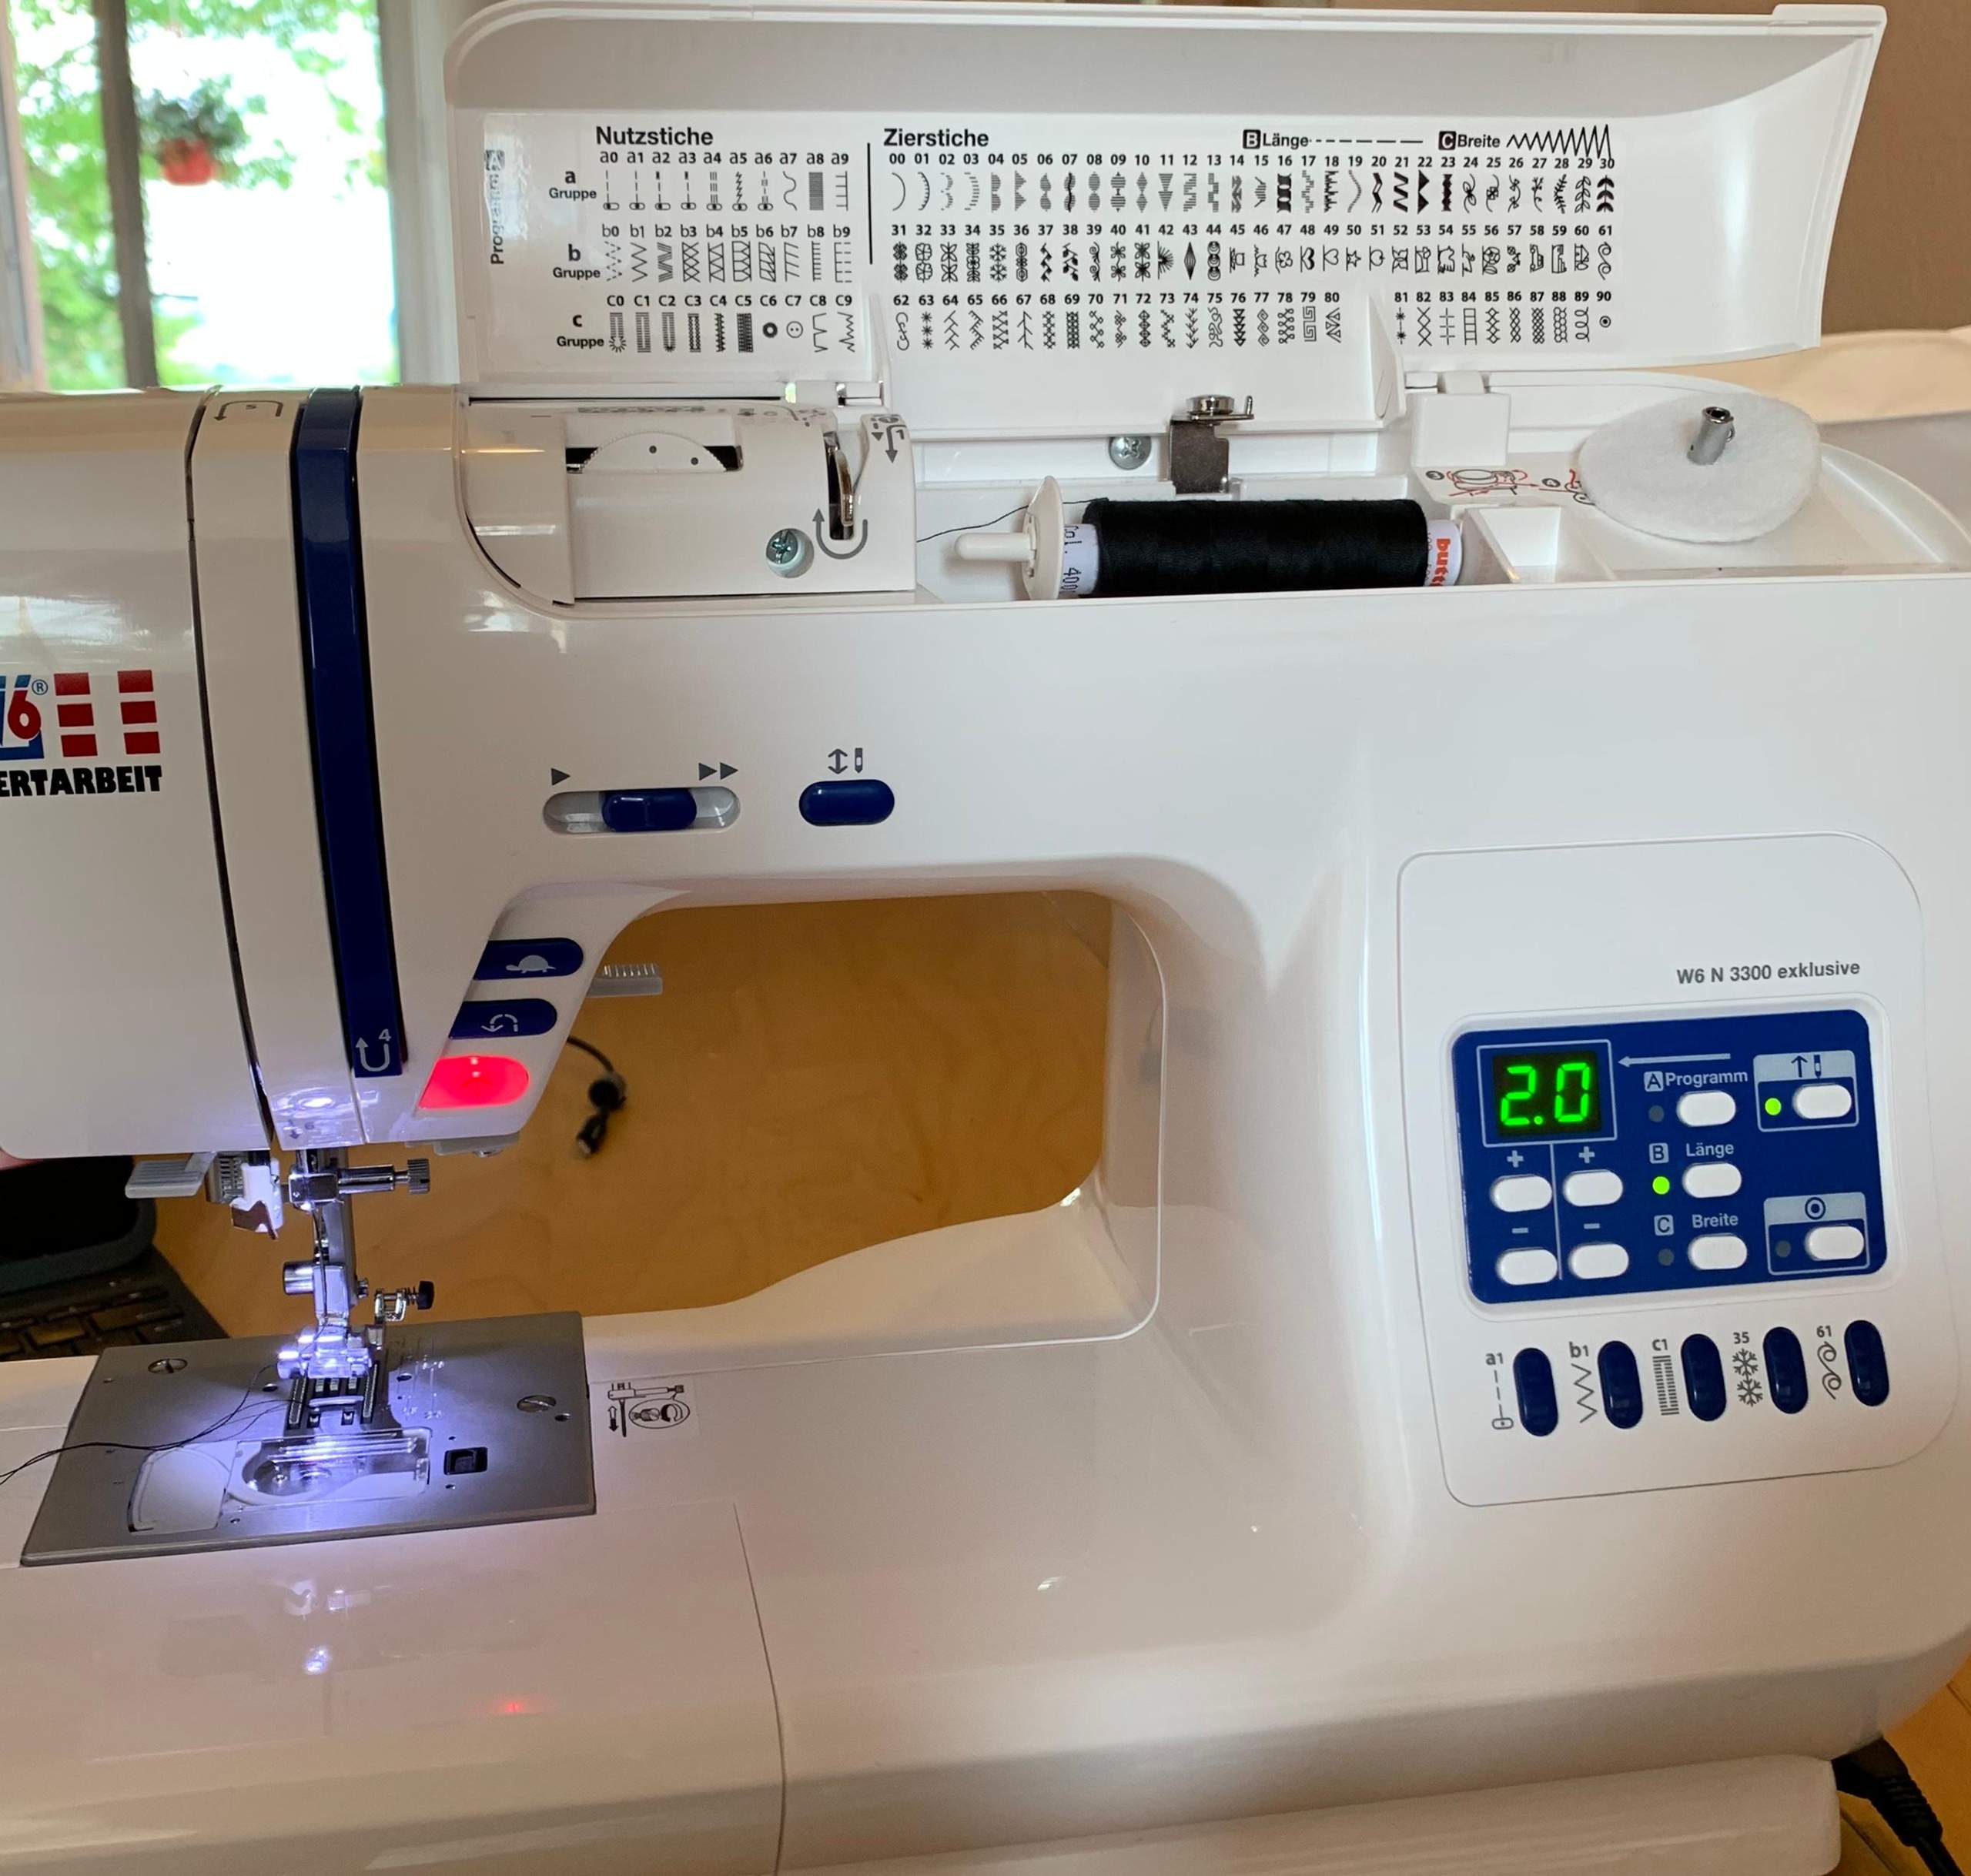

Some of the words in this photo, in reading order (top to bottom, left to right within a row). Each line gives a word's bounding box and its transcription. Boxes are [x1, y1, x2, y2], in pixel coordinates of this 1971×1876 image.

[596, 125, 714, 146] Nutzstiche
[883, 128, 989, 147] Zierstiche
[1263, 132, 1308, 150] Länge
[1457, 134, 1501, 148] Breite
[600, 151, 618, 163] a0
[627, 151, 644, 164] a1
[651, 152, 671, 164] a2
[678, 152, 696, 164] a3
[703, 152, 722, 164] a4
[729, 152, 748, 164] a5
[755, 152, 772, 165] a6
[779, 152, 797, 165] a7
[806, 152, 825, 165] a8
[831, 152, 849, 165] a9
[889, 152, 905, 165] 00
[914, 152, 929, 165] 01
[939, 153, 955, 166] 02
[963, 152, 979, 165] 03
[988, 153, 1004, 165] 04
[1012, 153, 1028, 166] 05
[1037, 153, 1053, 166] 06
[1062, 153, 1078, 166] 07
[1086, 154, 1103, 166] 08
[1110, 154, 1126, 166] 09
[1135, 154, 1149, 166] 10
[1160, 154, 1173, 166] 11
[1183, 154, 1197, 166] 12
[1207, 154, 1221, 166] 13
[1230, 154, 1244, 166] 14
[1254, 155, 1269, 166] 15
[1278, 155, 1293, 166] 16
[1301, 155, 1317, 166] 17
[1324, 155, 1339, 167] 18
[1348, 155, 1363, 167] 19
[1371, 155, 1387, 167] 20
[1394, 156, 1409, 168] 21
[1417, 156, 1433, 168] 22
[1441, 156, 1456, 168] 23
[1463, 156, 1478, 168] 24
[1486, 156, 1501, 168] 25
[1508, 157, 1524, 169] 26
[1532, 157, 1548, 169] 27
[564, 171, 576, 184] a
[549, 187, 597, 202] Gruppe
[602, 225, 619, 238] b0
[630, 225, 644, 239] b1
[655, 225, 672, 238] b2
[680, 225, 698, 238] b3
[706, 225, 724, 238] b4
[731, 225, 748, 238] b5
[756, 225, 774, 238] b6
[781, 225, 798, 238] b7
[807, 225, 825, 238] b8
[833, 225, 851, 238] b9
[892, 224, 905, 236] 31
[915, 224, 932, 236] 32
[940, 224, 955, 236] 33
[965, 224, 981, 236] 34
[989, 224, 1005, 236] 35
[1013, 224, 1029, 236] 36
[1038, 224, 1053, 236] 37
[1062, 224, 1079, 236] 38
[1086, 224, 1102, 236] 39
[1110, 224, 1126, 236] 40
[1135, 224, 1149, 236] 41
[1158, 224, 1174, 236] 42
[1183, 224, 1198, 236] 43
[1206, 223, 1222, 236] 44
[1230, 224, 1245, 236] 45
[1253, 224, 1269, 236] 46
[1277, 224, 1292, 236] 47
[1300, 224, 1315, 236] 48
[1346, 224, 1362, 236] 50
[1370, 224, 1384, 236] 51
[1393, 224, 1408, 236] 52
[1416, 224, 1431, 236] 53
[1438, 224, 1454, 236] 54
[1461, 224, 1476, 236] 55
[1484, 225, 1499, 236] 56
[1507, 224, 1522, 236] 57
[1529, 225, 1544, 236] 58
[1552, 225, 1567, 236] 59
[1574, 225, 1589, 236] 60
[1598, 225, 1612, 236] 61
[568, 243, 581, 262] b
[553, 266, 601, 280] Gruppe
[893, 294, 909, 306] 62
[919, 294, 935, 306] 63
[942, 294, 959, 306] 64
[967, 294, 983, 306] 65
[992, 294, 1008, 306] 66
[1016, 293, 1032, 306] 67
[1039, 293, 1056, 305] 68
[1064, 293, 1080, 305] 69
[1088, 293, 1103, 305] 70
[1113, 293, 1127, 304] 71
[1136, 293, 1151, 304] 72
[1160, 293, 1175, 304] 73
[1183, 292, 1199, 304] 74
[1207, 293, 1223, 303] 75
[1230, 292, 1247, 303] 76
[1253, 292, 1270, 303] 77
[1277, 292, 1293, 303] 78
[1300, 291, 1316, 303] 79
[1324, 292, 1340, 303] 80
[1394, 292, 1407, 303] 81
[1416, 291, 1431, 303] 82
[1439, 291, 1454, 302] 83
[1484, 291, 1500, 302] 85
[1507, 290, 1522, 302] 86
[1530, 291, 1544, 303] 87
[1551, 291, 1567, 302] 88
[1574, 291, 1589, 302] 89
[1596, 290, 1611, 302] 90
[557, 336, 604, 349] Gruppe
[1061, 567, 1081, 593] 400
[1677, 968, 1705, 984] W6
[1711, 967, 1724, 982] N
[1730, 965, 1772, 981] 3300
[1777, 961, 1860, 978] exklusive
[378, 1028, 392, 1042] 4
[1665, 1069, 1748, 1088] Programm
[1500, 1062, 1591, 1126] 2.0
[1685, 1141, 1735, 1159] Länge
[1692, 1212, 1738, 1229] Breite
[1733, 1332, 1750, 1344] 35
[1816, 1326, 1832, 1338] 61
[1568, 1341, 1589, 1358] b1
[1486, 1353, 1503, 1366] a1
